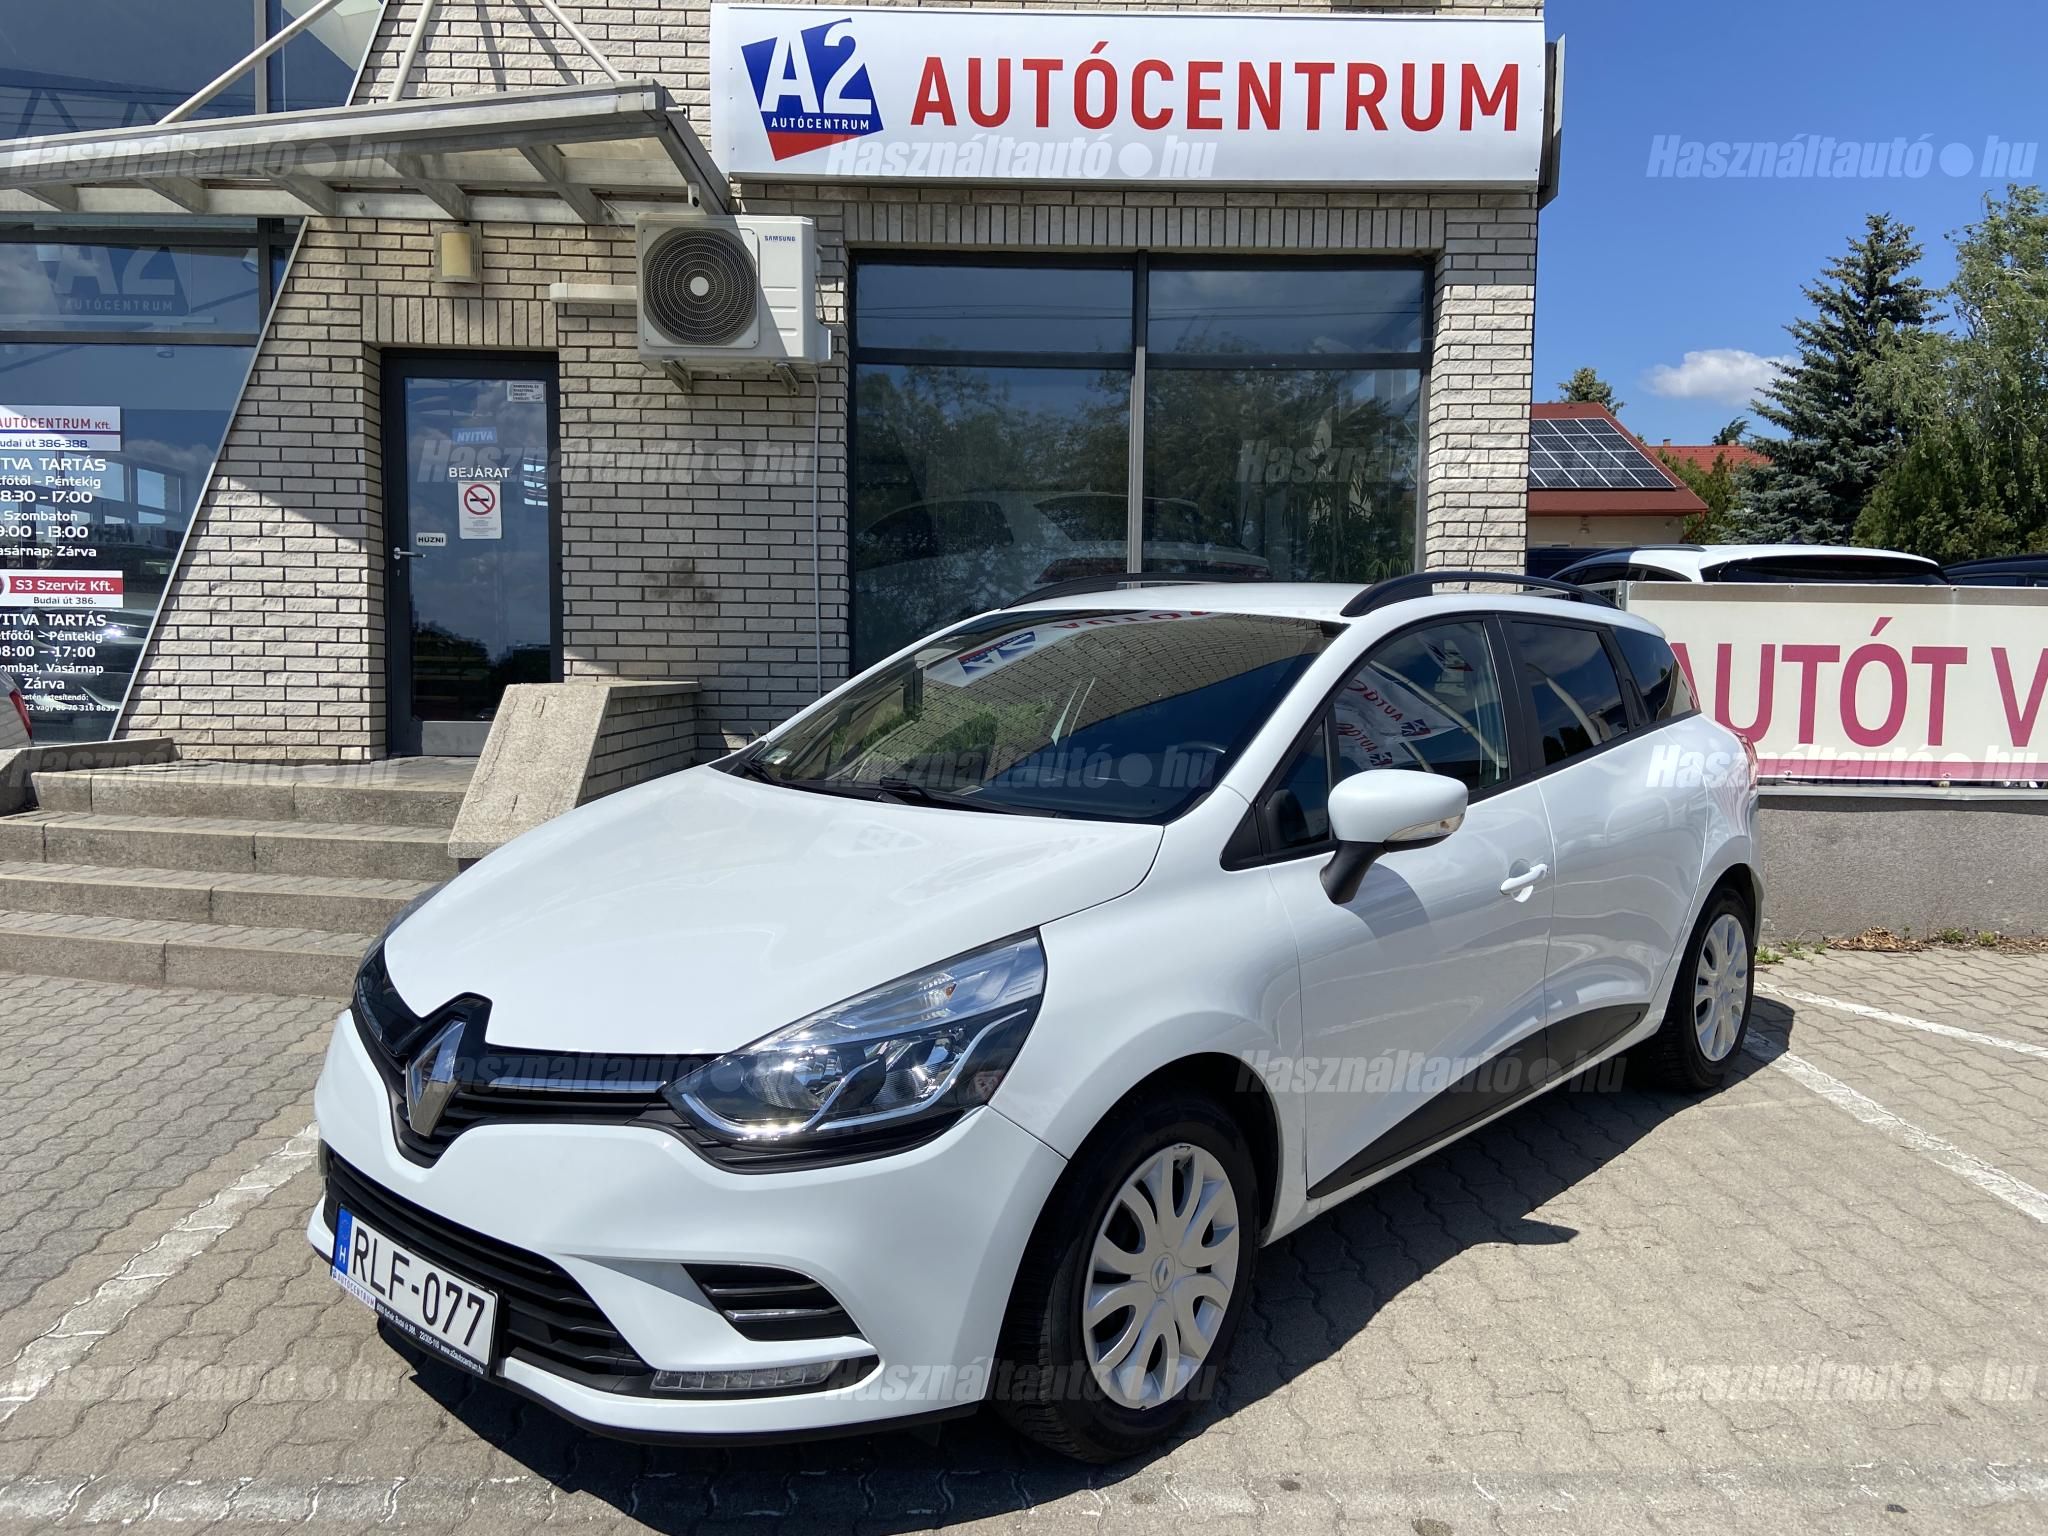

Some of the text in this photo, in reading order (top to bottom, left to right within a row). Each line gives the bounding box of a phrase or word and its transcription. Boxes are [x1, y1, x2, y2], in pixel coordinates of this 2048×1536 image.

[760, 21, 872, 115] A2
[910, 41, 1519, 132] AUTÓCENTRUM
[771, 115, 869, 130] AUTÓCENTRUM
[95, 421, 111, 430] Kft.
[0, 438, 22, 448] udai
[457, 431, 494, 442] NYITVA
[0, 455, 107, 472] TVA TARTÁS
[448, 465, 511, 478] BEJÁRAT
[0, 475, 31, 486] főtől
[45, 475, 101, 489] Péntekig
[52, 490, 94, 503] 17:00
[4, 510, 78, 522] Szombaton
[48, 526, 89, 539] 13:00
[418, 535, 444, 544] HÚZNI
[56, 546, 97, 557] Zárva
[15, 580, 114, 592] S3 Szerviz Kft.
[33, 597, 97, 605] Budai út 386.
[0, 611, 107, 627] ITVA TARTÁS
[0, 629, 34, 641] tfőtől
[49, 630, 103, 644] Péntekig
[0, 645, 35, 657] 8:00
[54, 646, 96, 658] 17:00
[0, 662, 41, 675] ombat,
[24, 676, 65, 690] Zárva
[338, 1245, 347, 1264] H
[352, 1225, 486, 1347] RLF-077
